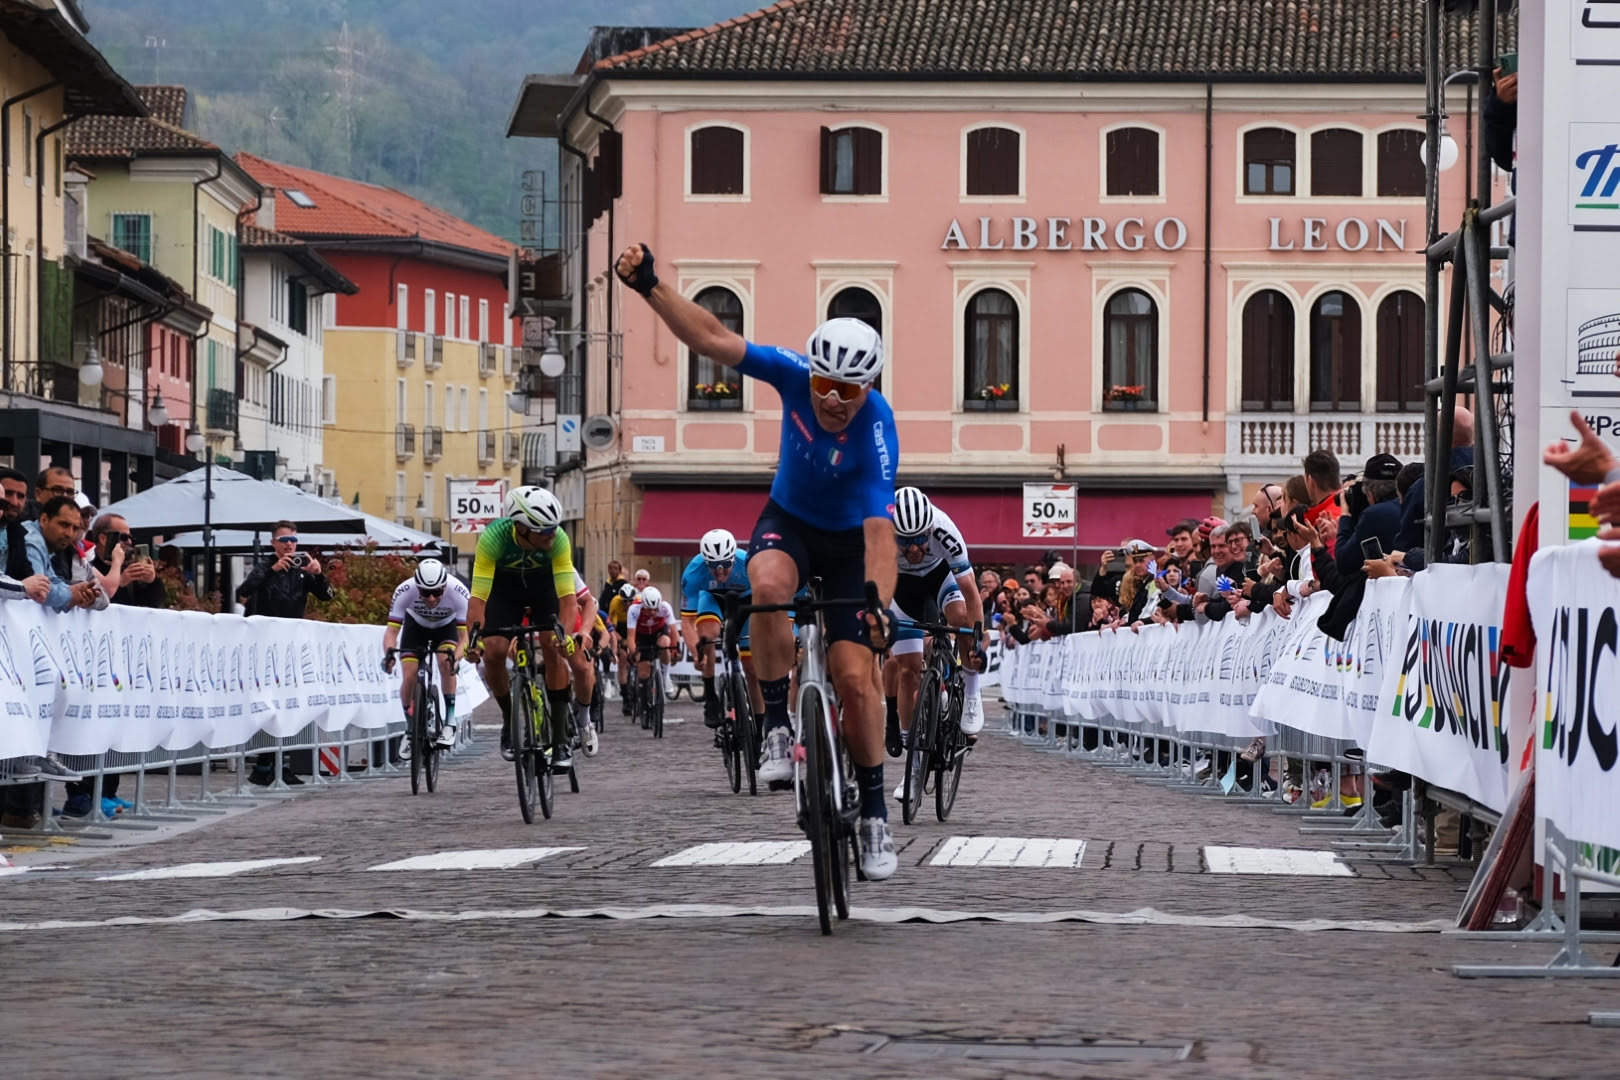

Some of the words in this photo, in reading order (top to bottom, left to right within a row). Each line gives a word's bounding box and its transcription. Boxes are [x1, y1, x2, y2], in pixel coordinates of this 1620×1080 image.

[941, 217, 1188, 251] ALBERGO
[1268, 217, 1409, 251] LEON
[457, 498, 481, 514] 50
[483, 504, 494, 513] M
[1032, 502, 1055, 518] 50
[1058, 509, 1069, 518] M
